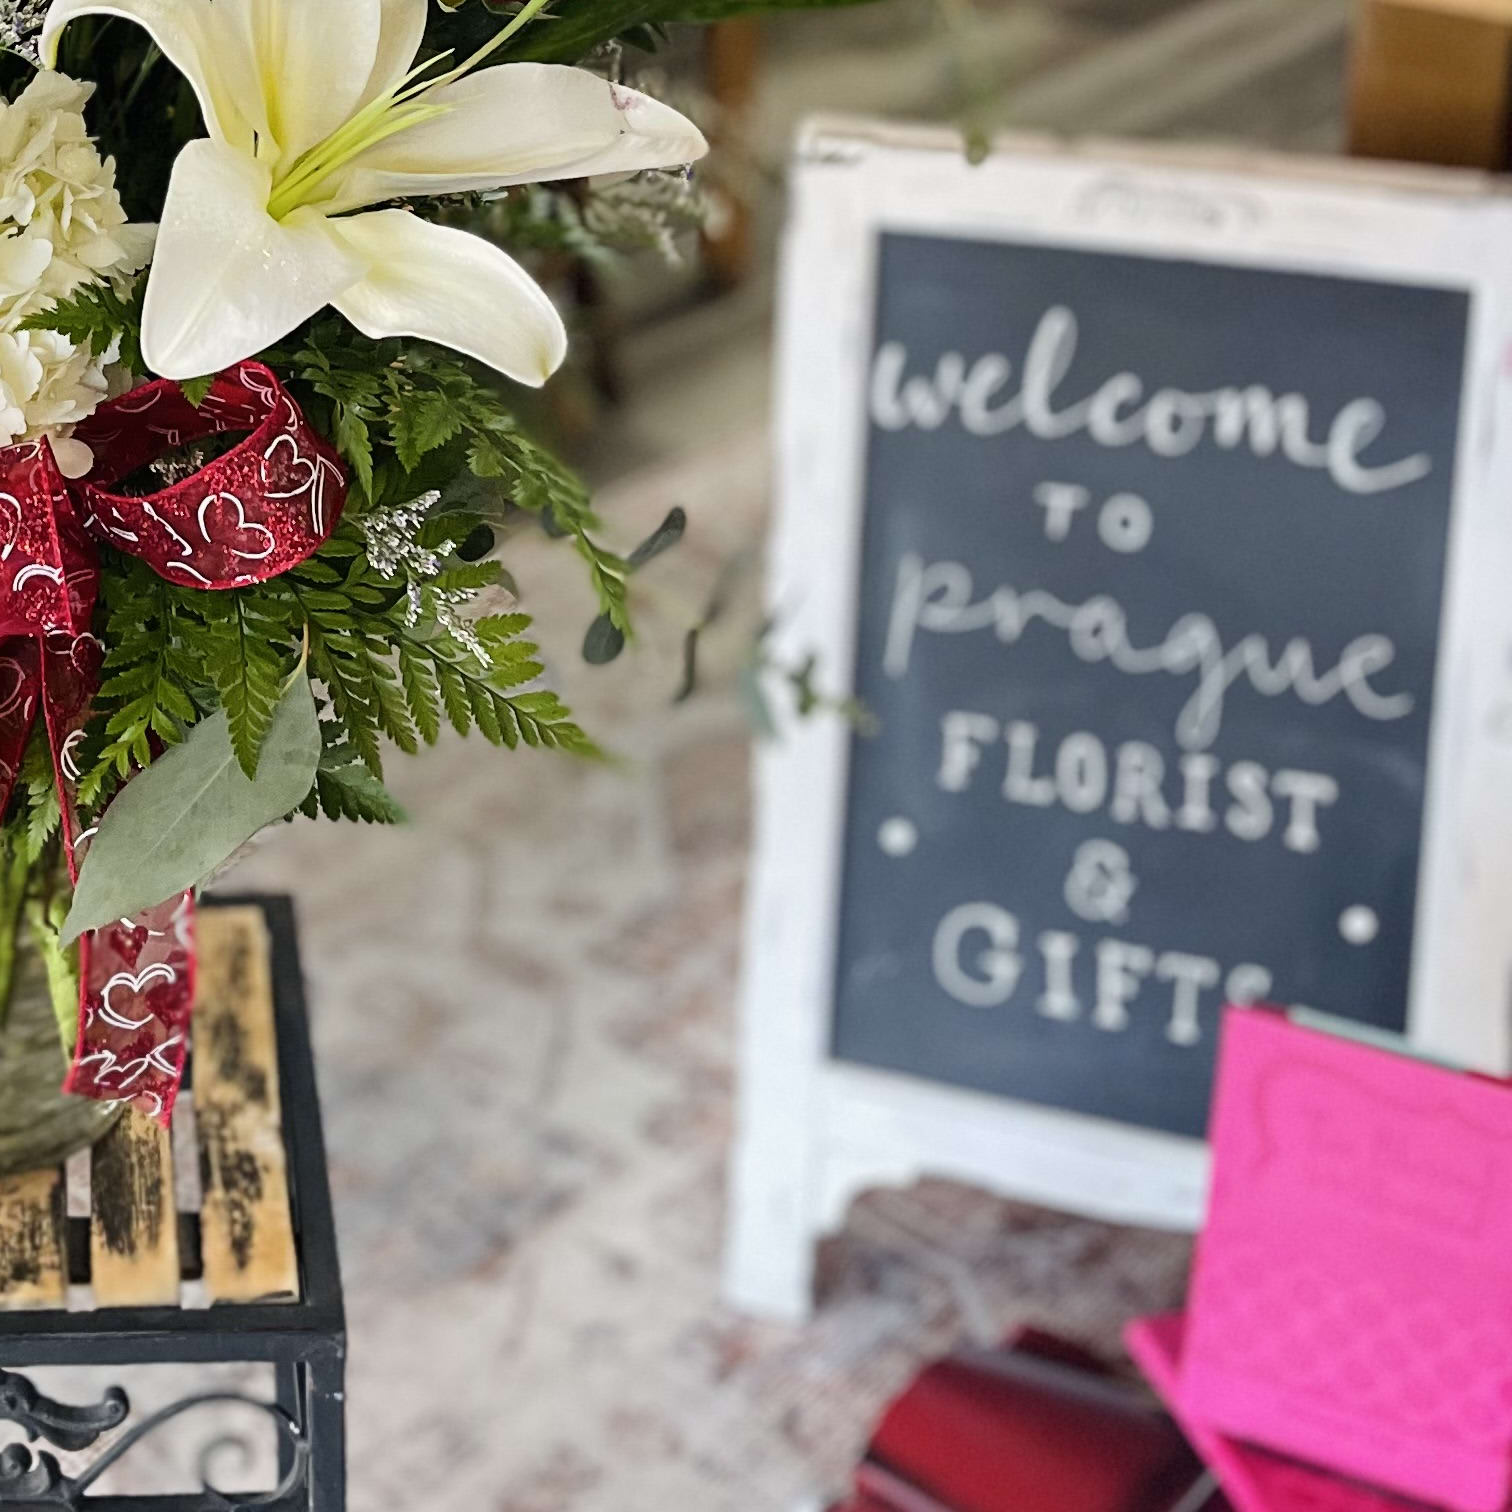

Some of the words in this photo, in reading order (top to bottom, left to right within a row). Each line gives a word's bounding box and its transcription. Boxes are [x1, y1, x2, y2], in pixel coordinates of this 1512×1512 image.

[871, 305, 1432, 492] welcome
[1033, 481, 1154, 553] TO
[884, 552, 1414, 750] prague
[936, 710, 1338, 853] FLORIST
[1064, 838, 1138, 924] &
